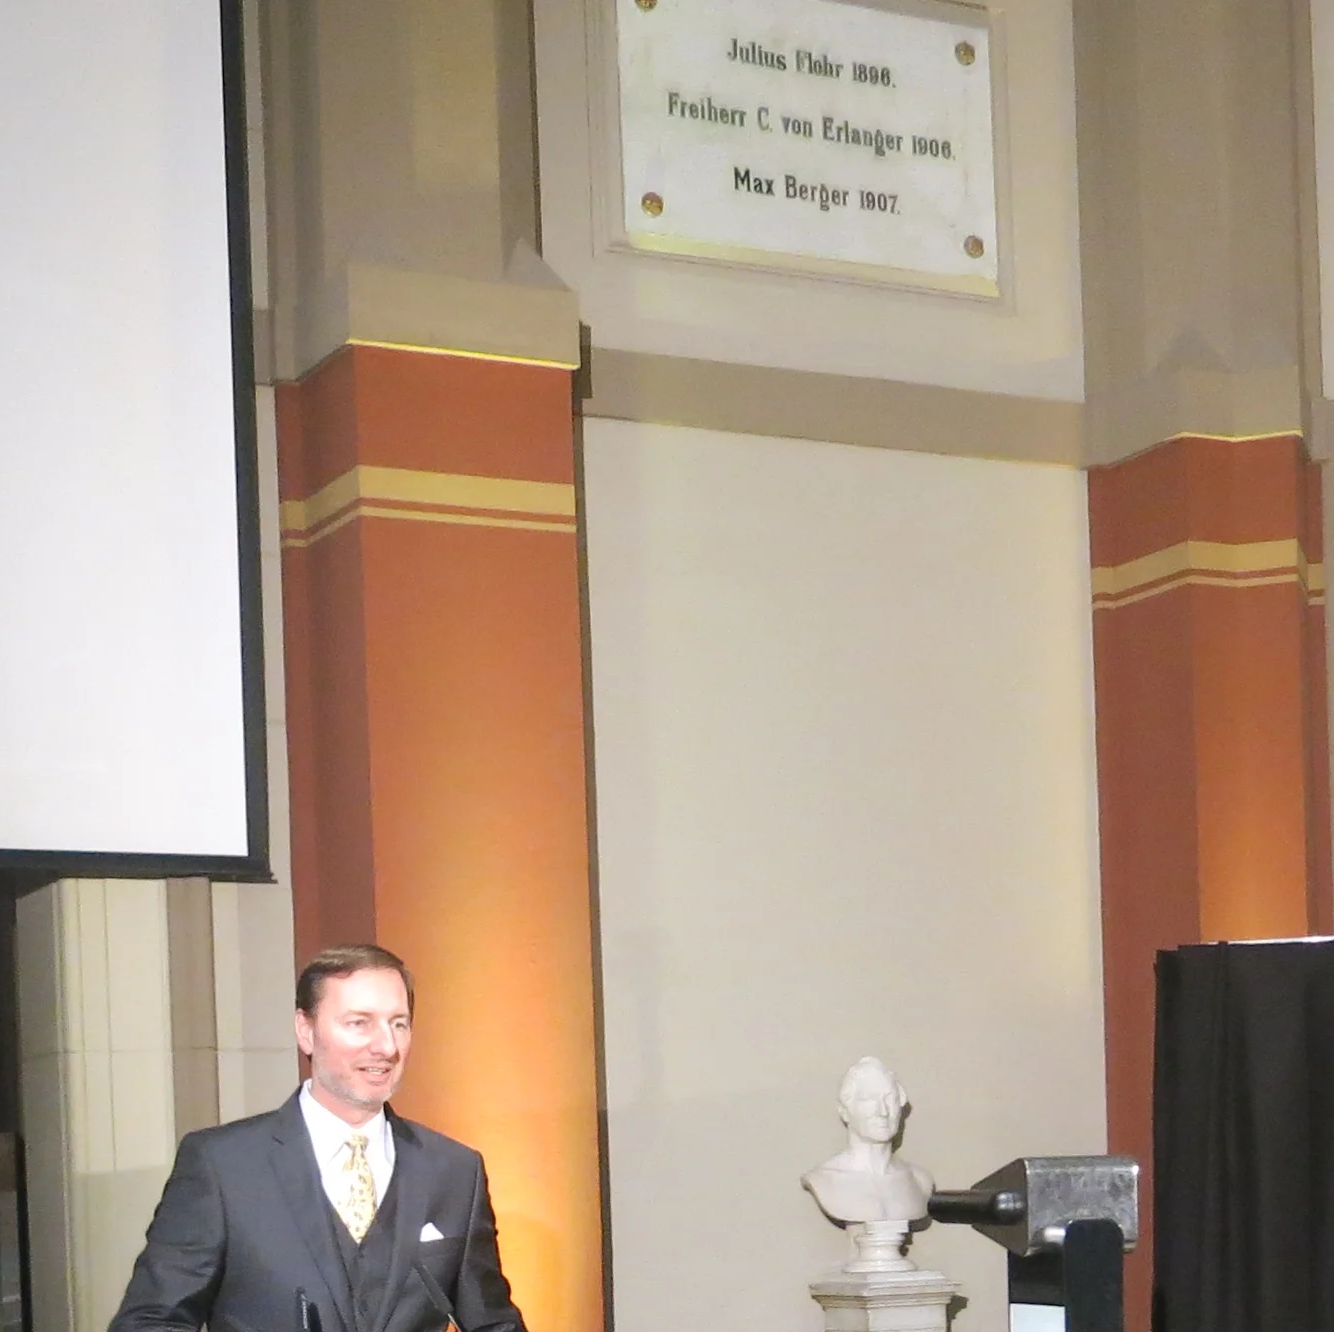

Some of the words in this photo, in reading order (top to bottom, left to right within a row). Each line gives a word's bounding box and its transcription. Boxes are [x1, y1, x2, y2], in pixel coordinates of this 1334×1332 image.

[727, 37, 787, 72] Julius
[795, 49, 844, 79] Flohr
[668, 92, 746, 127] Freiherr
[782, 116, 814, 140] von
[822, 117, 904, 157] Erlanger
[733, 166, 775, 197] Max
[785, 176, 849, 212] Berger
